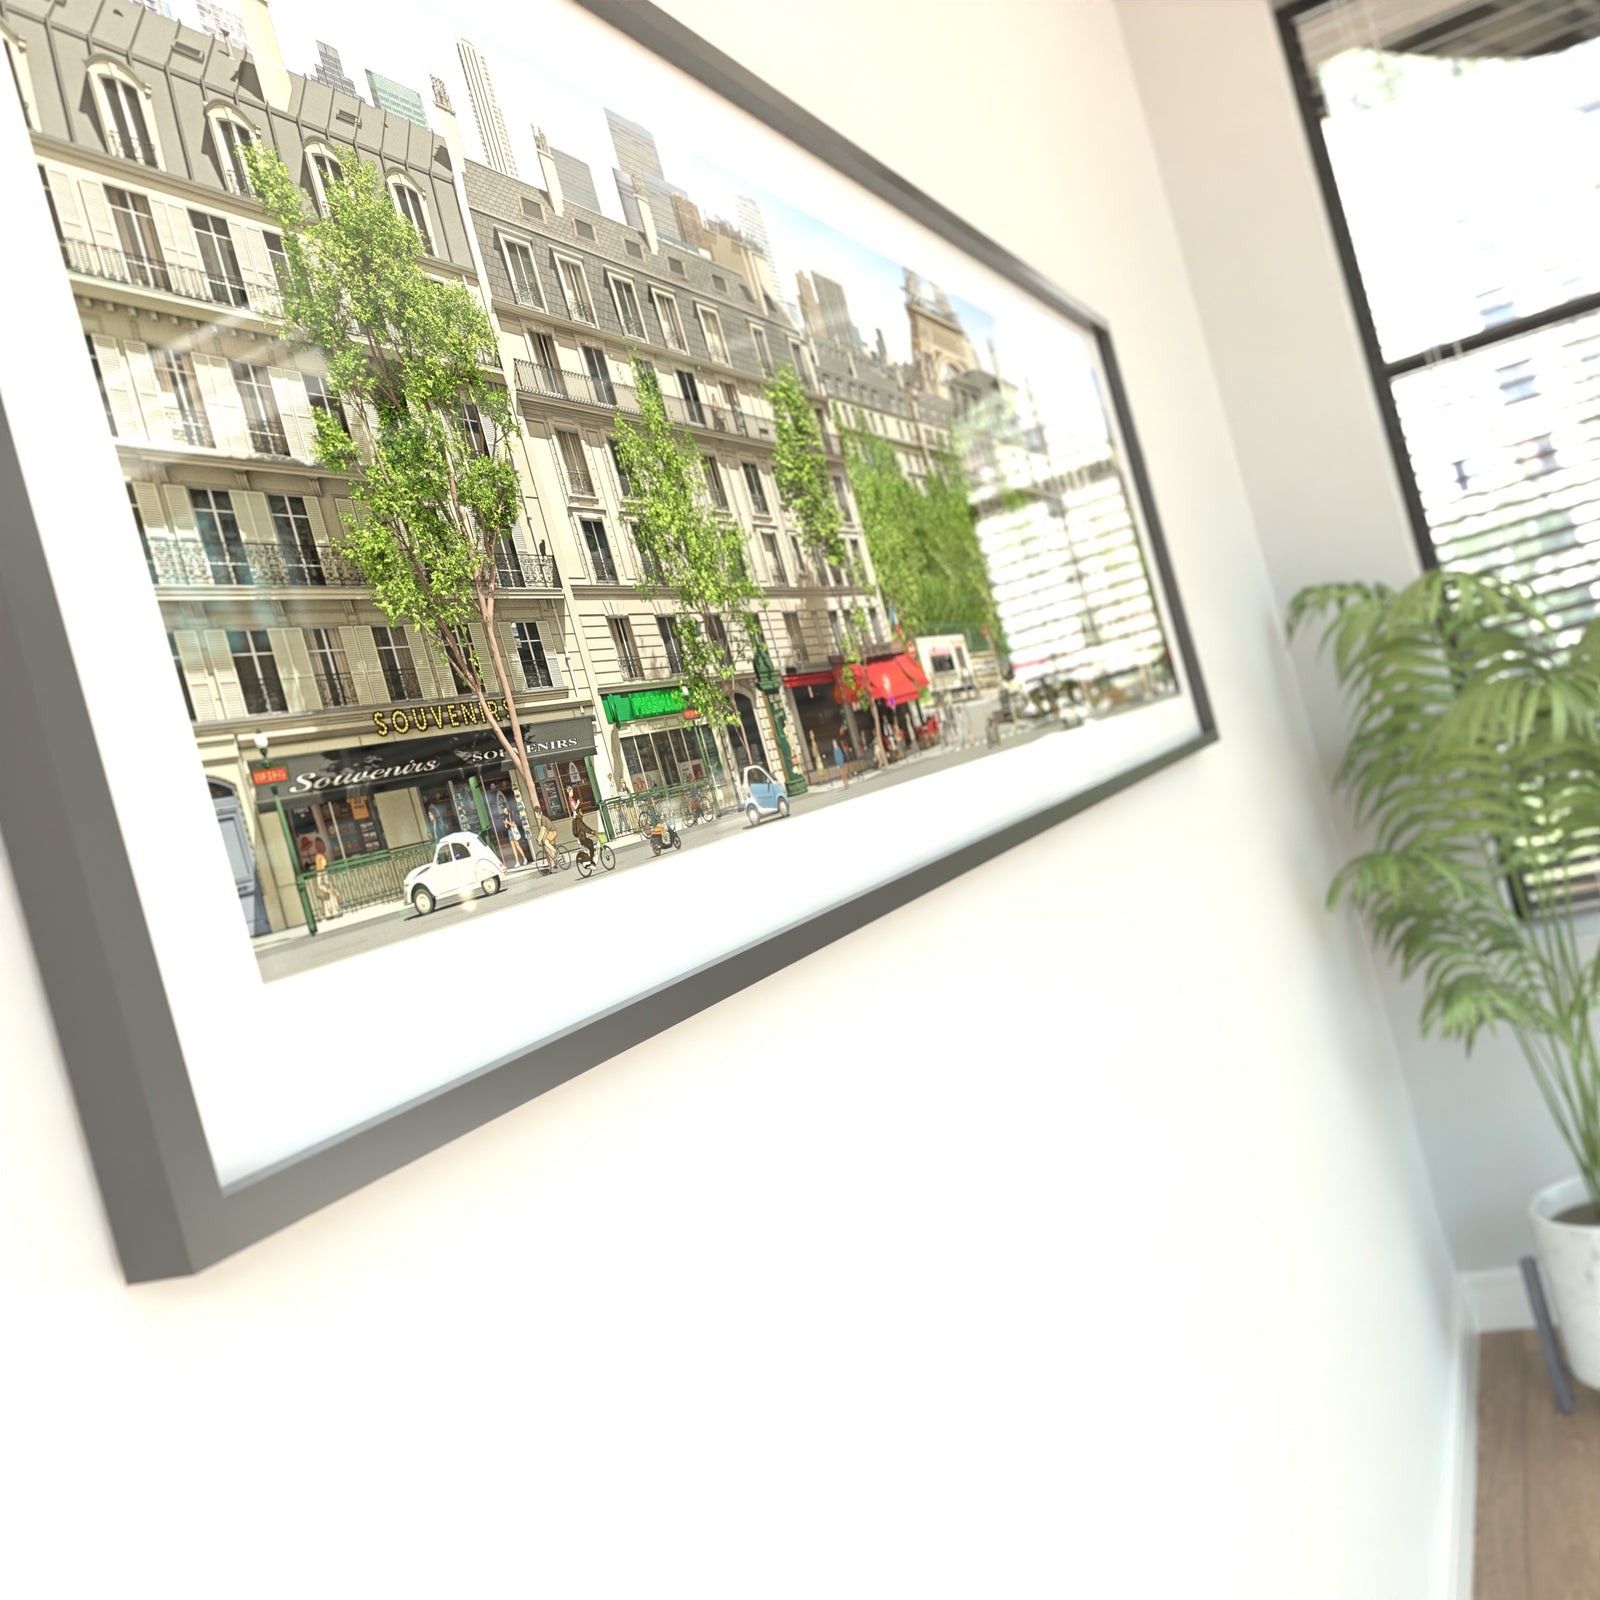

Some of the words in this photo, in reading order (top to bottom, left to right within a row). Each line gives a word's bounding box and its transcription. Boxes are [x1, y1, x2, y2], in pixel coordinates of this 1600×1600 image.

[373, 698, 512, 736] SOUVENIRS
[632, 690, 687, 716] PHARMAC
[289, 758, 441, 793] Souvenirs
